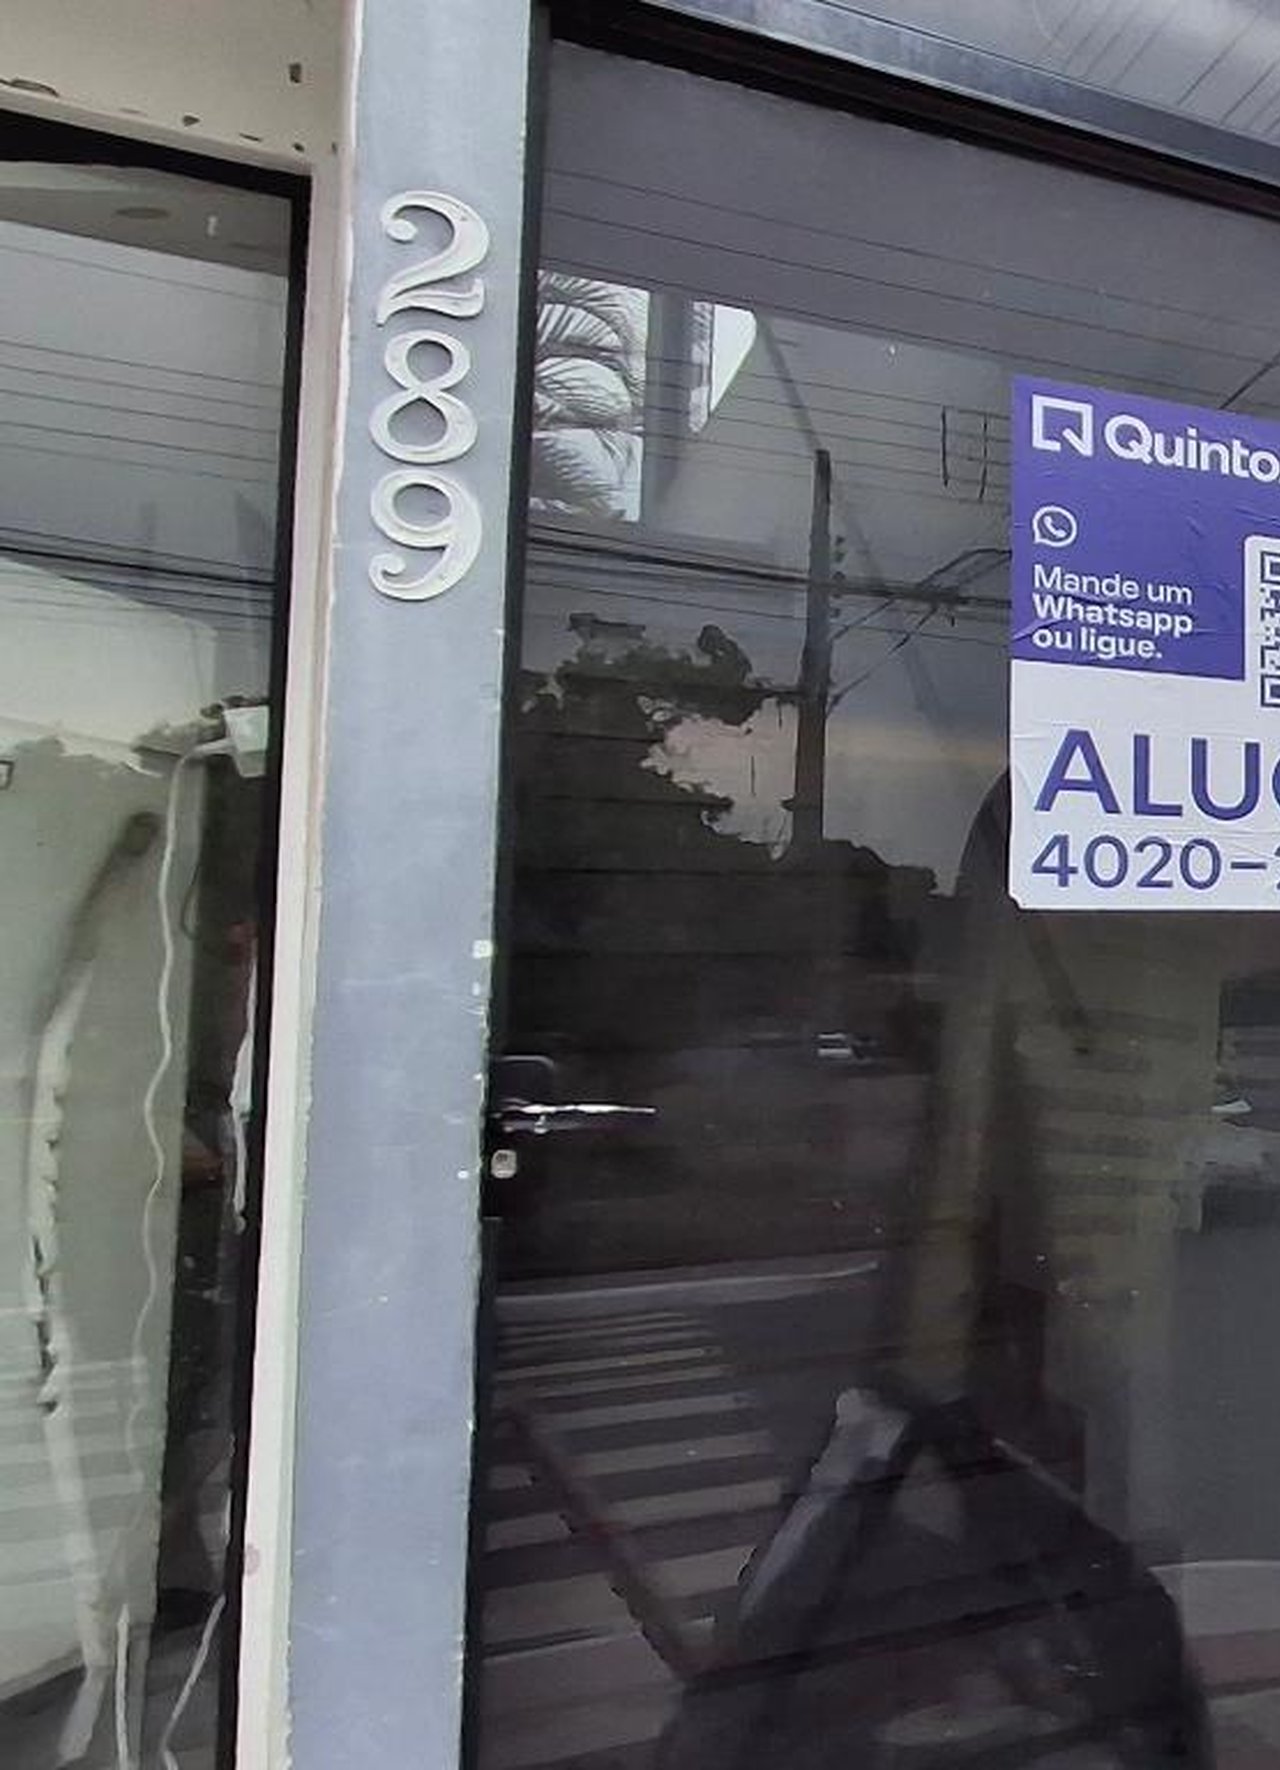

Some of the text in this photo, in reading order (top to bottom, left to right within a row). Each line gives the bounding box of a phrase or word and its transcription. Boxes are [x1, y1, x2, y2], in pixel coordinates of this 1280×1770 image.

[368, 190, 490, 602] 289
[1033, 563, 1193, 606] Mande um
[1031, 592, 1194, 639] Whatsapp
[1032, 625, 1163, 660] ou ligue.
